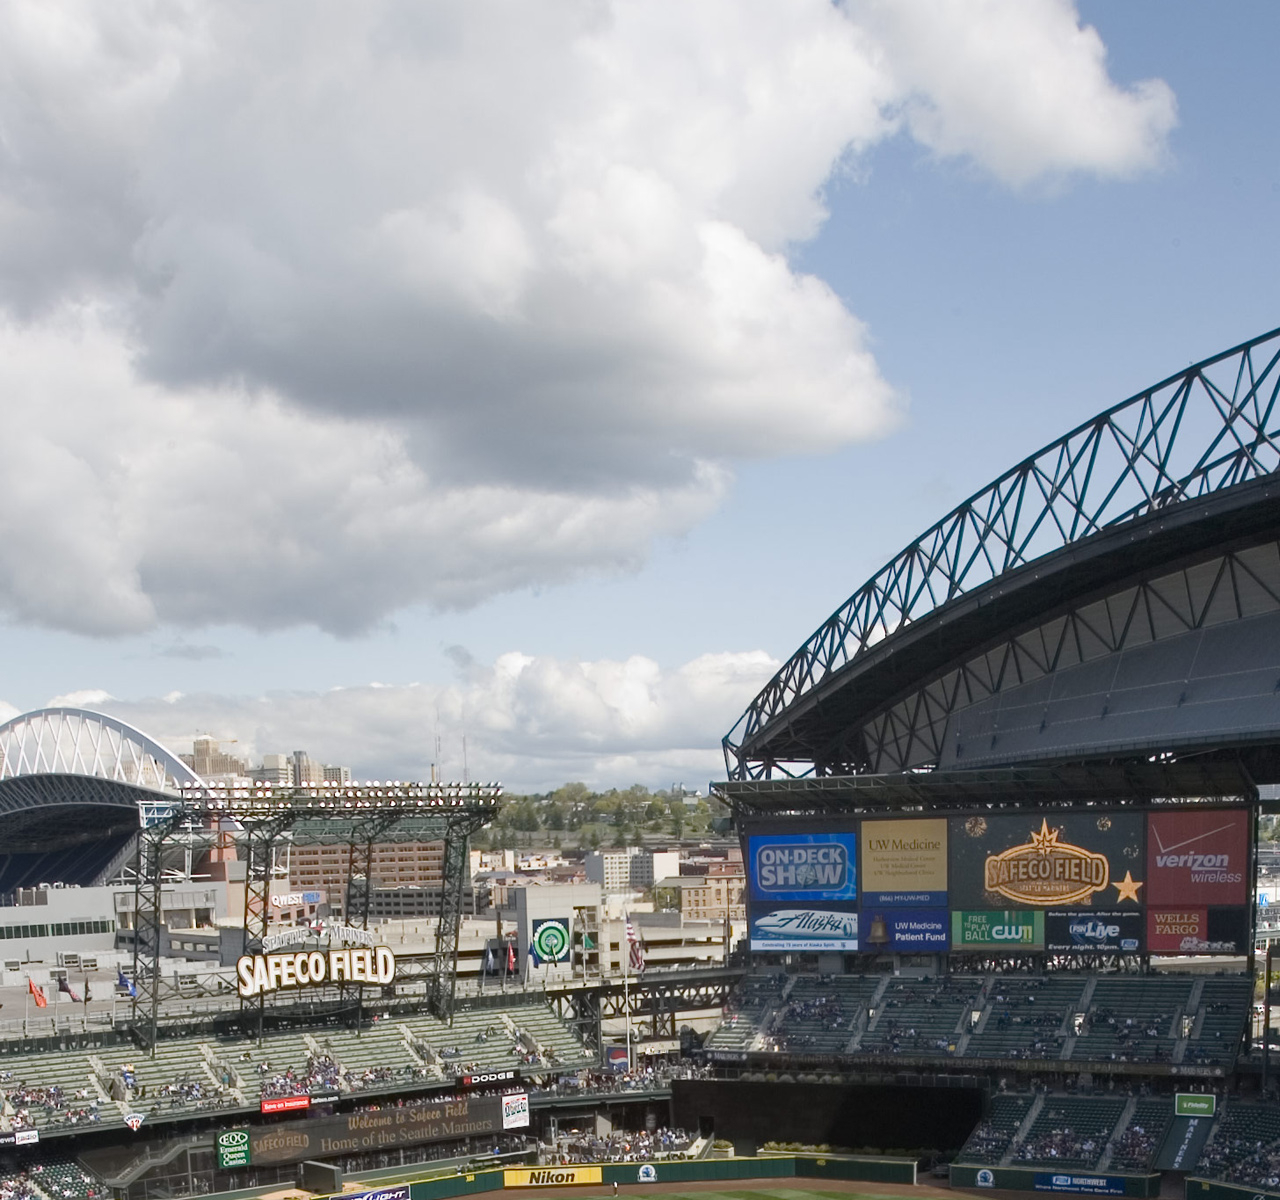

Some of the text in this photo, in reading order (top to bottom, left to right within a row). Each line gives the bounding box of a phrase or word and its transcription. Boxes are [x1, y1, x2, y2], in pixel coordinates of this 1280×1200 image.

[869, 839, 941, 850] UW Medicine
[1156, 851, 1229, 871] verizon
[987, 857, 1105, 886] SAFECO FIELD
[1191, 871, 1242, 884] wireless
[271, 893, 303, 908] QWEST
[778, 912, 842, 932] Alaska
[968, 915, 987, 924] FREE
[1154, 914, 1200, 923] WELLS
[895, 922, 942, 930] UW Medicine
[971, 923, 990, 932] PLAY
[1086, 922, 1120, 939] Live
[1154, 924, 1199, 935] FARGO
[895, 932, 946, 941] Patient Fund
[965, 931, 991, 941] BALL
[1072, 943, 1095, 951] night.
[236, 945, 396, 998] SAFECO FIELD
[471, 1071, 515, 1084] DODGE
[348, 1102, 469, 1131] Welcome to Safeco Field
[17, 1132, 37, 1142] radio
[221, 1133, 246, 1144] EQC
[321, 1138, 358, 1152] Home
[362, 1132, 375, 1146] of
[377, 1130, 396, 1145] the
[399, 1124, 438, 1141] Seattle
[442, 1119, 493, 1136] Mariners
[220, 1144, 248, 1154] Emerald
[253, 1134, 310, 1155] SAFECO FIELD
[1172, 1119, 1199, 1169] MARINERS
[223, 1152, 245, 1161] Queen
[223, 1158, 247, 1167] Casino
[529, 1171, 575, 1185] Nikon
